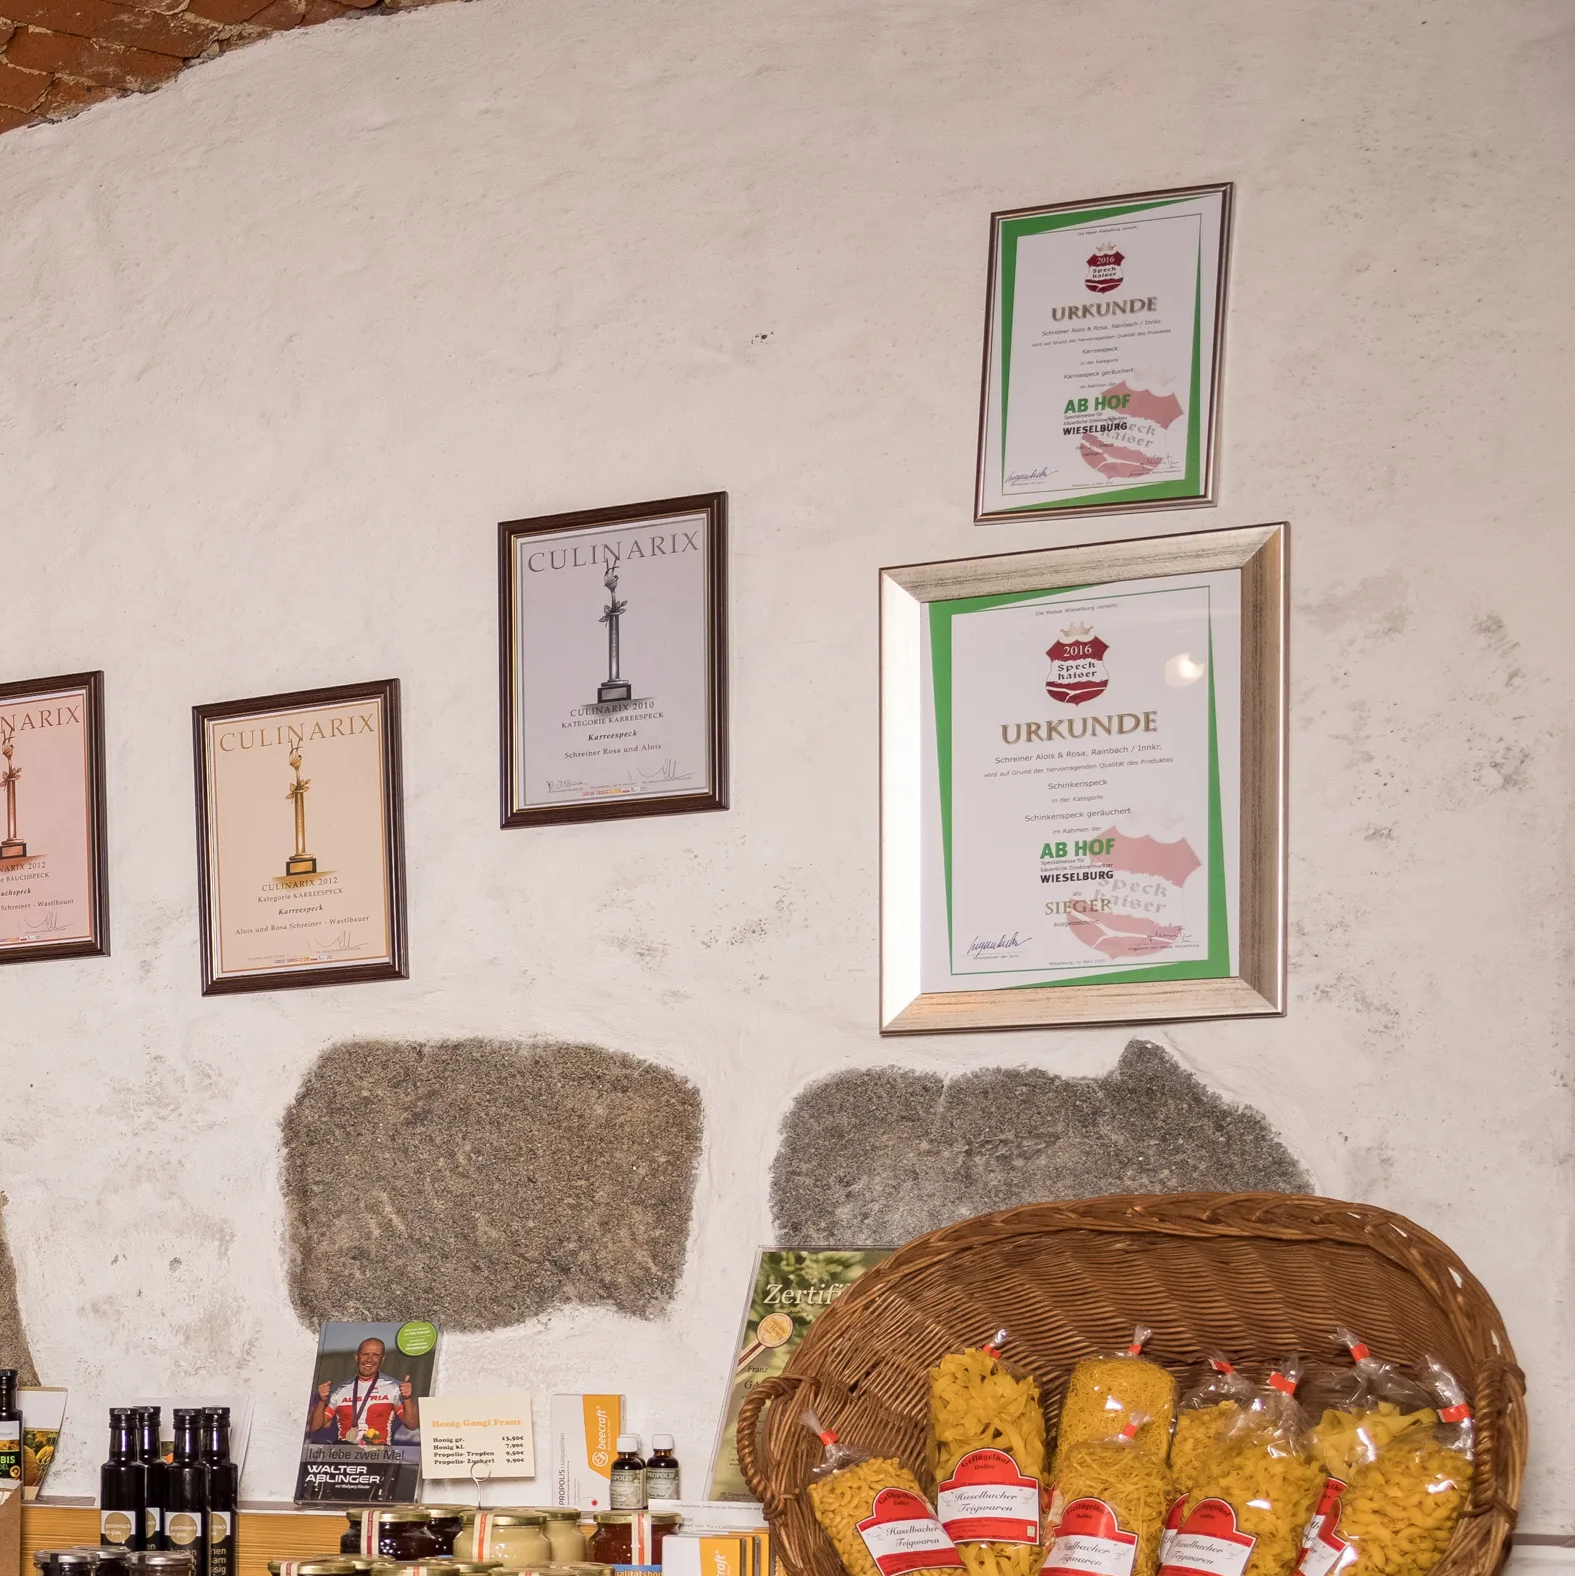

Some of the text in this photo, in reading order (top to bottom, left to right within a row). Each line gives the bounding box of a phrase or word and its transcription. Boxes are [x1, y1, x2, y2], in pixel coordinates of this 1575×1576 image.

[1096, 255, 1115, 265] 2016
[1051, 296, 1158, 323] URKUNDE
[1063, 394, 1131, 415] AB HOF
[1062, 422, 1128, 436] WIESELBURG
[527, 529, 700, 573] CULINARIX
[1063, 644, 1092, 657] 2016
[570, 701, 655, 717] CULINARIX 2010
[561, 711, 664, 729] KATEGORIE KARREESPECK
[999, 709, 1158, 745] URKUNDE
[220, 713, 375, 753] CULINARIX
[587, 729, 638, 742] Karreespeck
[564, 742, 662, 759] Schreiner Rosa und Alois
[995, 755, 1033, 764] Schreiner
[1035, 752, 1055, 761] Alois
[1066, 750, 1088, 758] Rosa,
[1091, 746, 1128, 756] Rainbach
[1138, 743, 1162, 751] Innkr.
[1047, 779, 1108, 790] Schinkenspeck
[1025, 807, 1131, 823] Schinkenspeck geräuchert
[1039, 837, 1116, 859] AB HOF
[27, 861, 46, 870] 2012
[261, 877, 338, 892] CULINARIX 2012
[1040, 870, 1114, 884] WIESELBURG
[278, 904, 324, 916] Karreespeck
[1044, 898, 1113, 916] SIEGER
[432, 1420, 461, 1428] Honig
[493, 1418, 522, 1426] Franz
[596, 1409, 607, 1450] beecraft
[309, 1448, 405, 1460] Ich lebe zwei Mal
[307, 1465, 367, 1474] WALTER
[305, 1474, 380, 1484] ABLINGER
[558, 1469, 566, 1507] PROPOLIS
